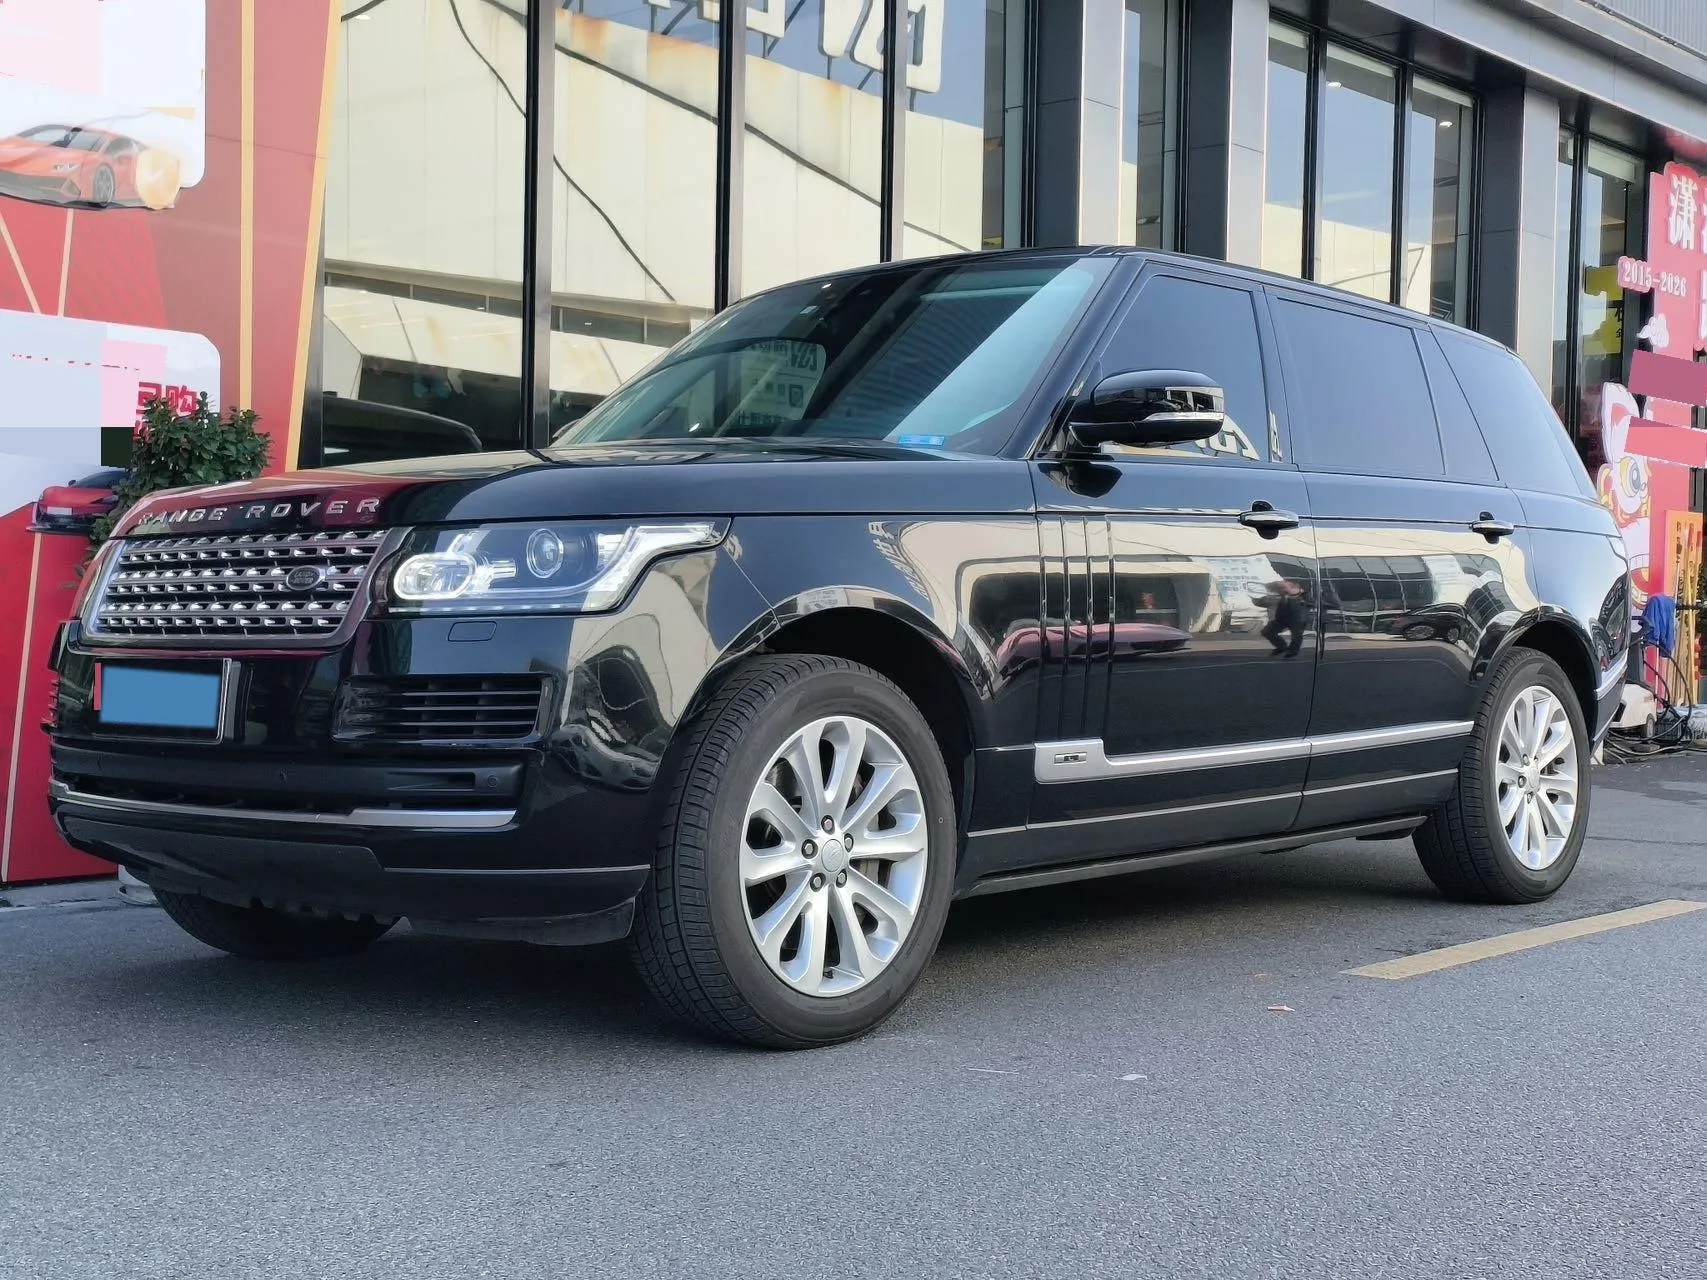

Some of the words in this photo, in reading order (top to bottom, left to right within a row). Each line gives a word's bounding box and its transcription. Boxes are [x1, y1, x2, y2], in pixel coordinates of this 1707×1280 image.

[1668, 173, 1707, 250] 潇
[1624, 260, 1687, 297] 2015-2026
[244, 499, 380, 519] ROVER
